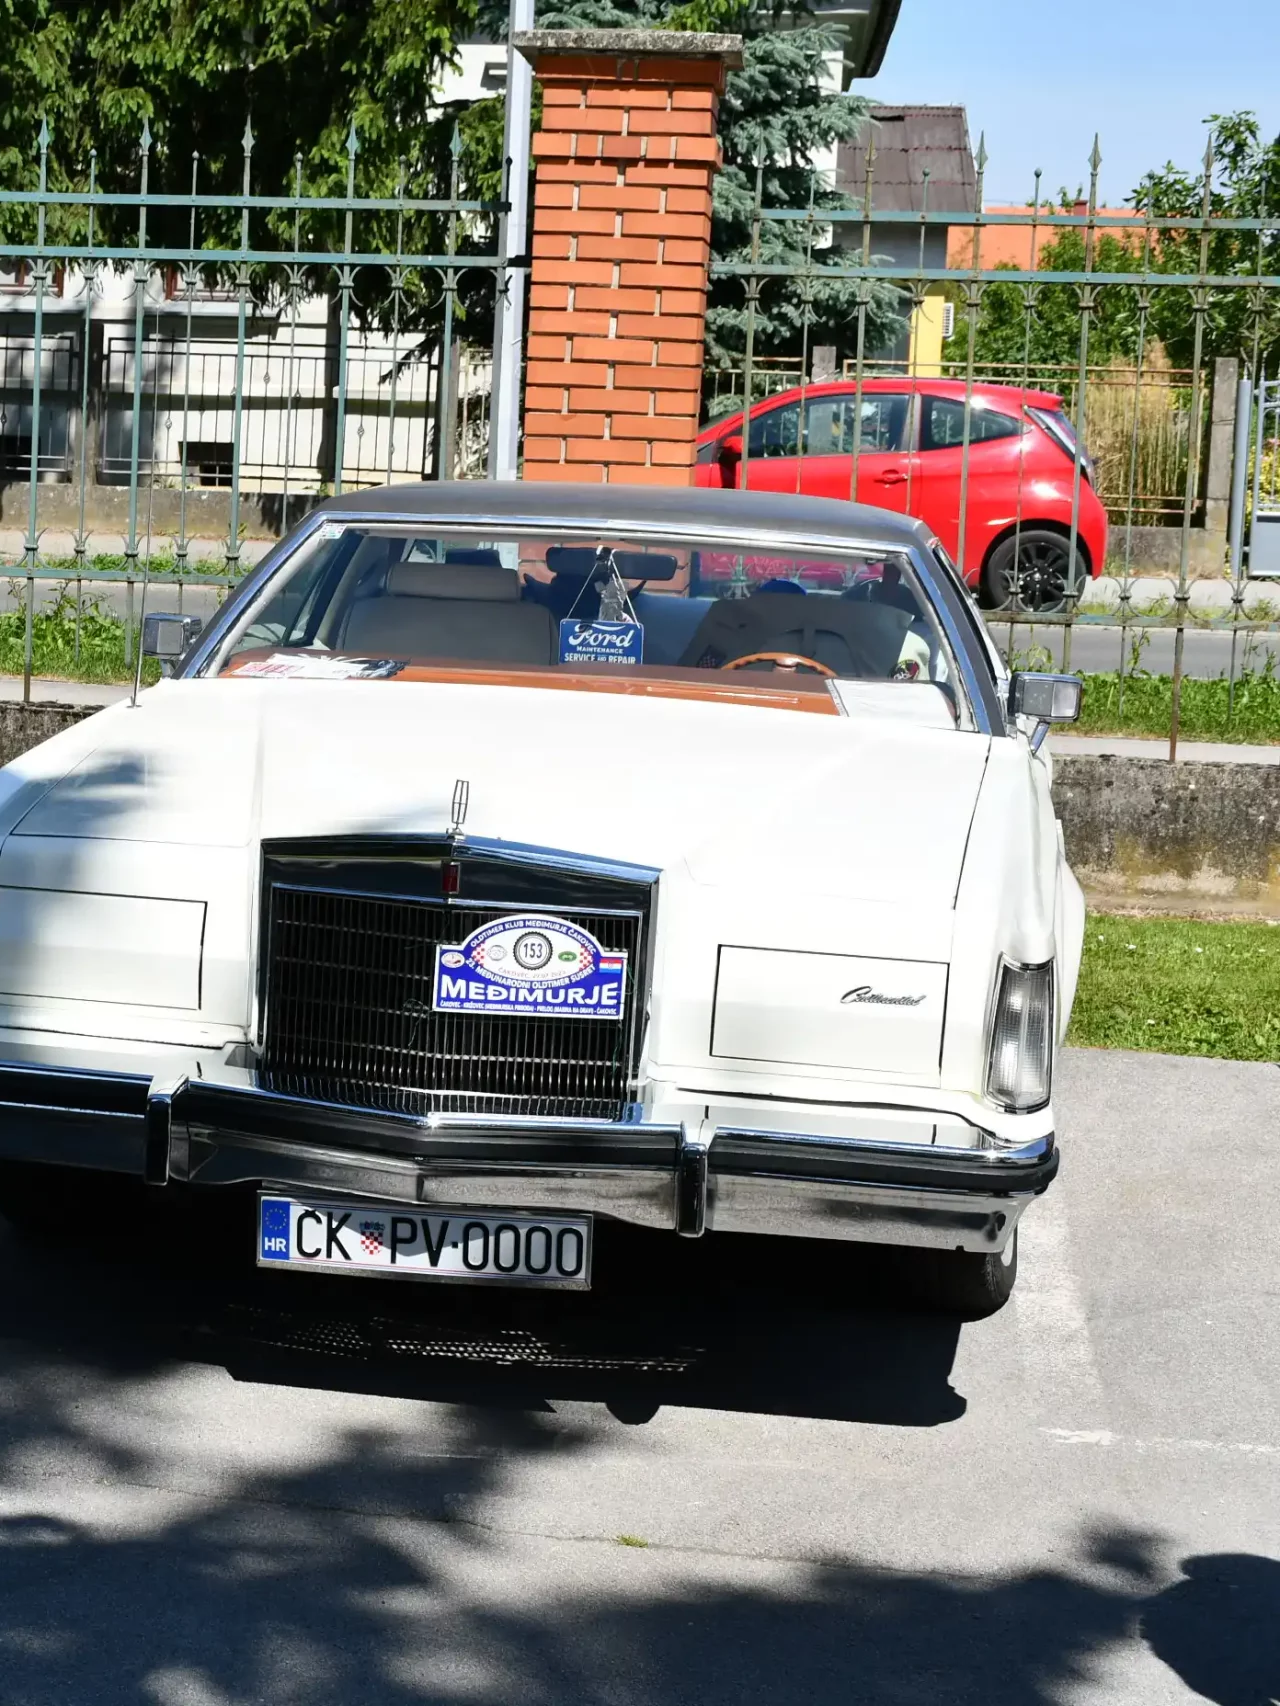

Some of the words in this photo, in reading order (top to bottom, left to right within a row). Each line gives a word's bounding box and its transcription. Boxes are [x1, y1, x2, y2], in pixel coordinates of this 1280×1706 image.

[568, 623, 635, 648] Ford
[564, 653, 596, 662] SERVICE
[608, 654, 636, 664] REPAIR
[576, 646, 624, 654] MAINTENANCE
[470, 926, 505, 947] OLDTIMER
[505, 920, 524, 930] KLUB
[525, 920, 569, 934] MEĐIMURJE
[568, 928, 597, 954] ČAKOVEC
[523, 943, 543, 958] 153
[475, 965, 531, 989] MEĐUNARODNI
[531, 976, 571, 989] OLDTIMER
[570, 963, 596, 983] SUSRET
[440, 974, 618, 1006] MEĐIMURJE
[264, 1237, 287, 1253] HR
[296, 1209, 352, 1261] ČK
[390, 1216, 584, 1277] PV-0000
